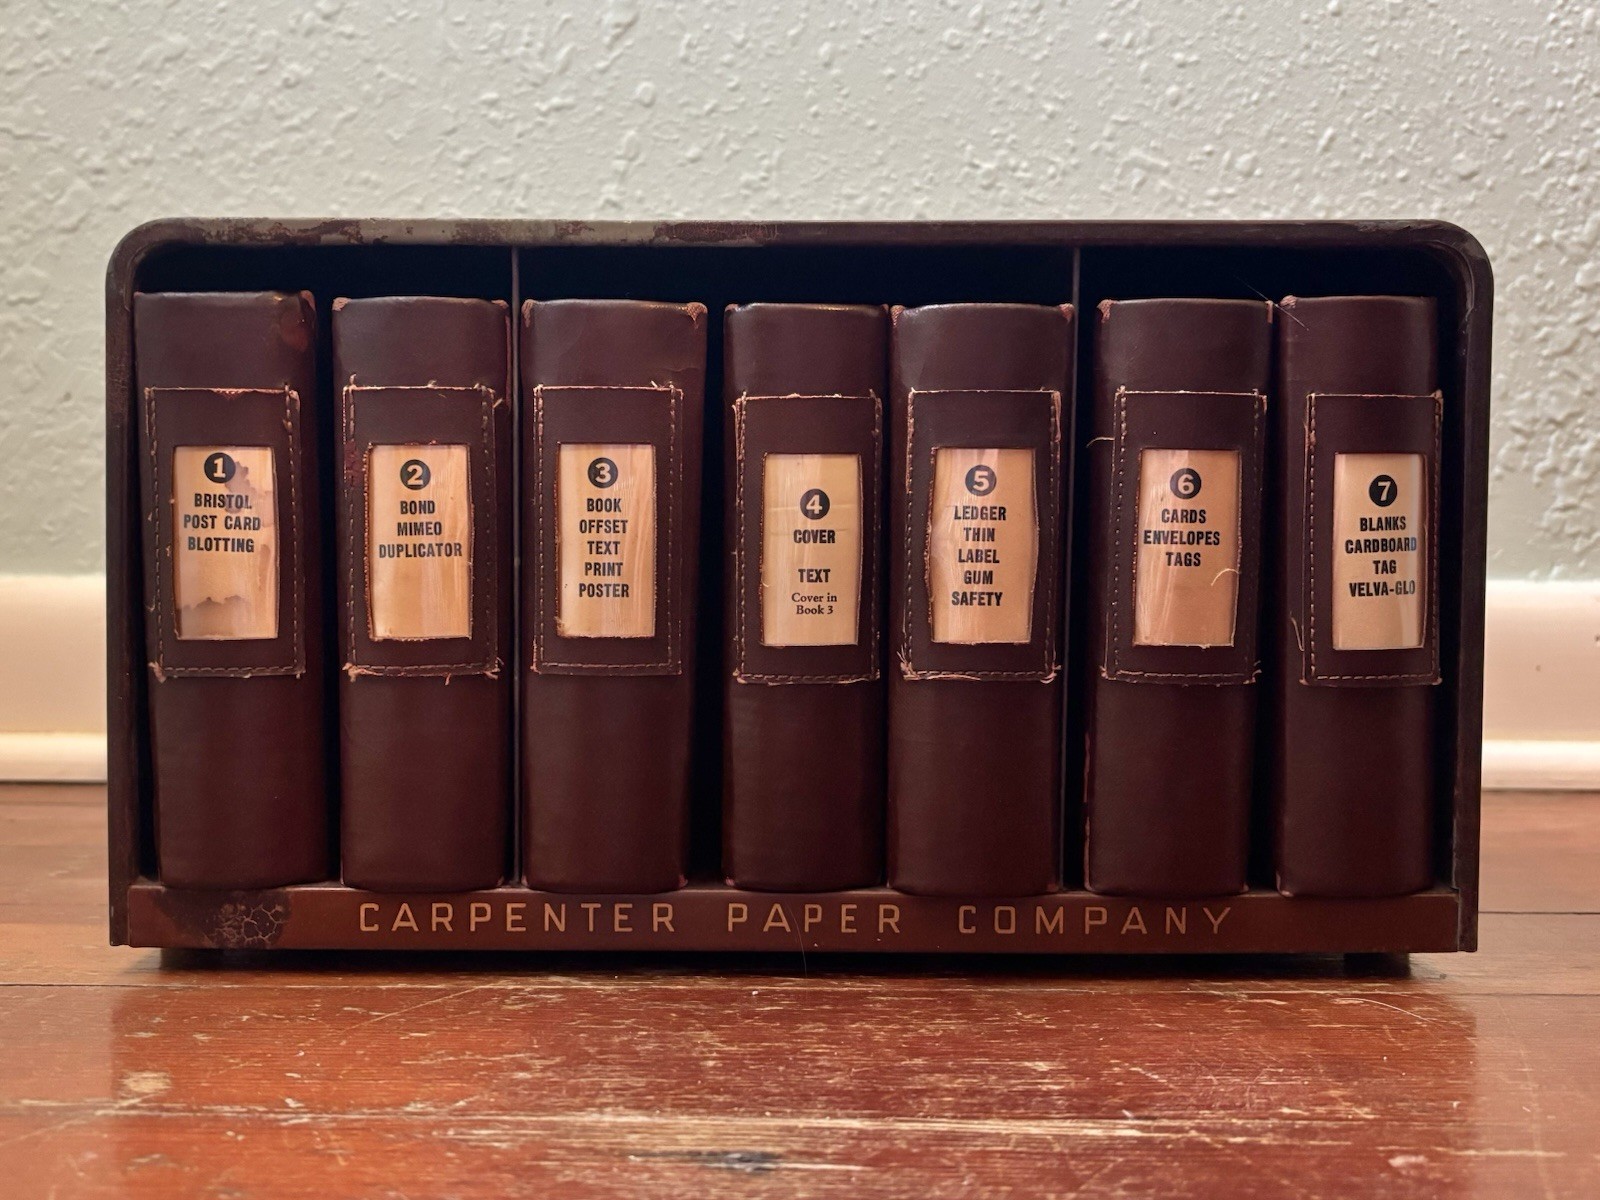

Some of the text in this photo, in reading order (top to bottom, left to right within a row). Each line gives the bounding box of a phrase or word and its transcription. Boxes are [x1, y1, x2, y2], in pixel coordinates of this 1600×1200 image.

[194, 492, 252, 510] BRISTOL
[400, 500, 436, 515] BOND
[586, 497, 622, 513] BOOK
[954, 505, 1007, 521] LEDGER
[1161, 508, 1207, 524] CARDS
[183, 514, 261, 531] POST CARD
[397, 521, 443, 537] MIMEO
[579, 519, 628, 534] OFFSET
[1359, 515, 1407, 532] BLANKS
[793, 529, 836, 544] COVER
[963, 527, 996, 543] THIN
[1143, 530, 1221, 546] ENVELOPES
[187, 536, 255, 553] BLOTTING
[379, 542, 463, 559] DUPLICATOR
[587, 540, 621, 555] TEXT
[1345, 537, 1417, 554] CARDBOARD
[958, 548, 1001, 564] LABEL
[1165, 551, 1202, 567] TAGS
[584, 561, 624, 577] PRINT
[1372, 559, 1397, 575] TAG
[798, 568, 831, 583] TEXT
[964, 570, 994, 585] GUM
[579, 582, 630, 598] POSTER
[1349, 580, 1416, 598] VELVA-GLO
[791, 592, 838, 603] Cover in
[951, 591, 1003, 607] SAFETY
[796, 604, 834, 615] Book 3
[359, 902, 1231, 935] CARPENTER PAPER COMPANY
